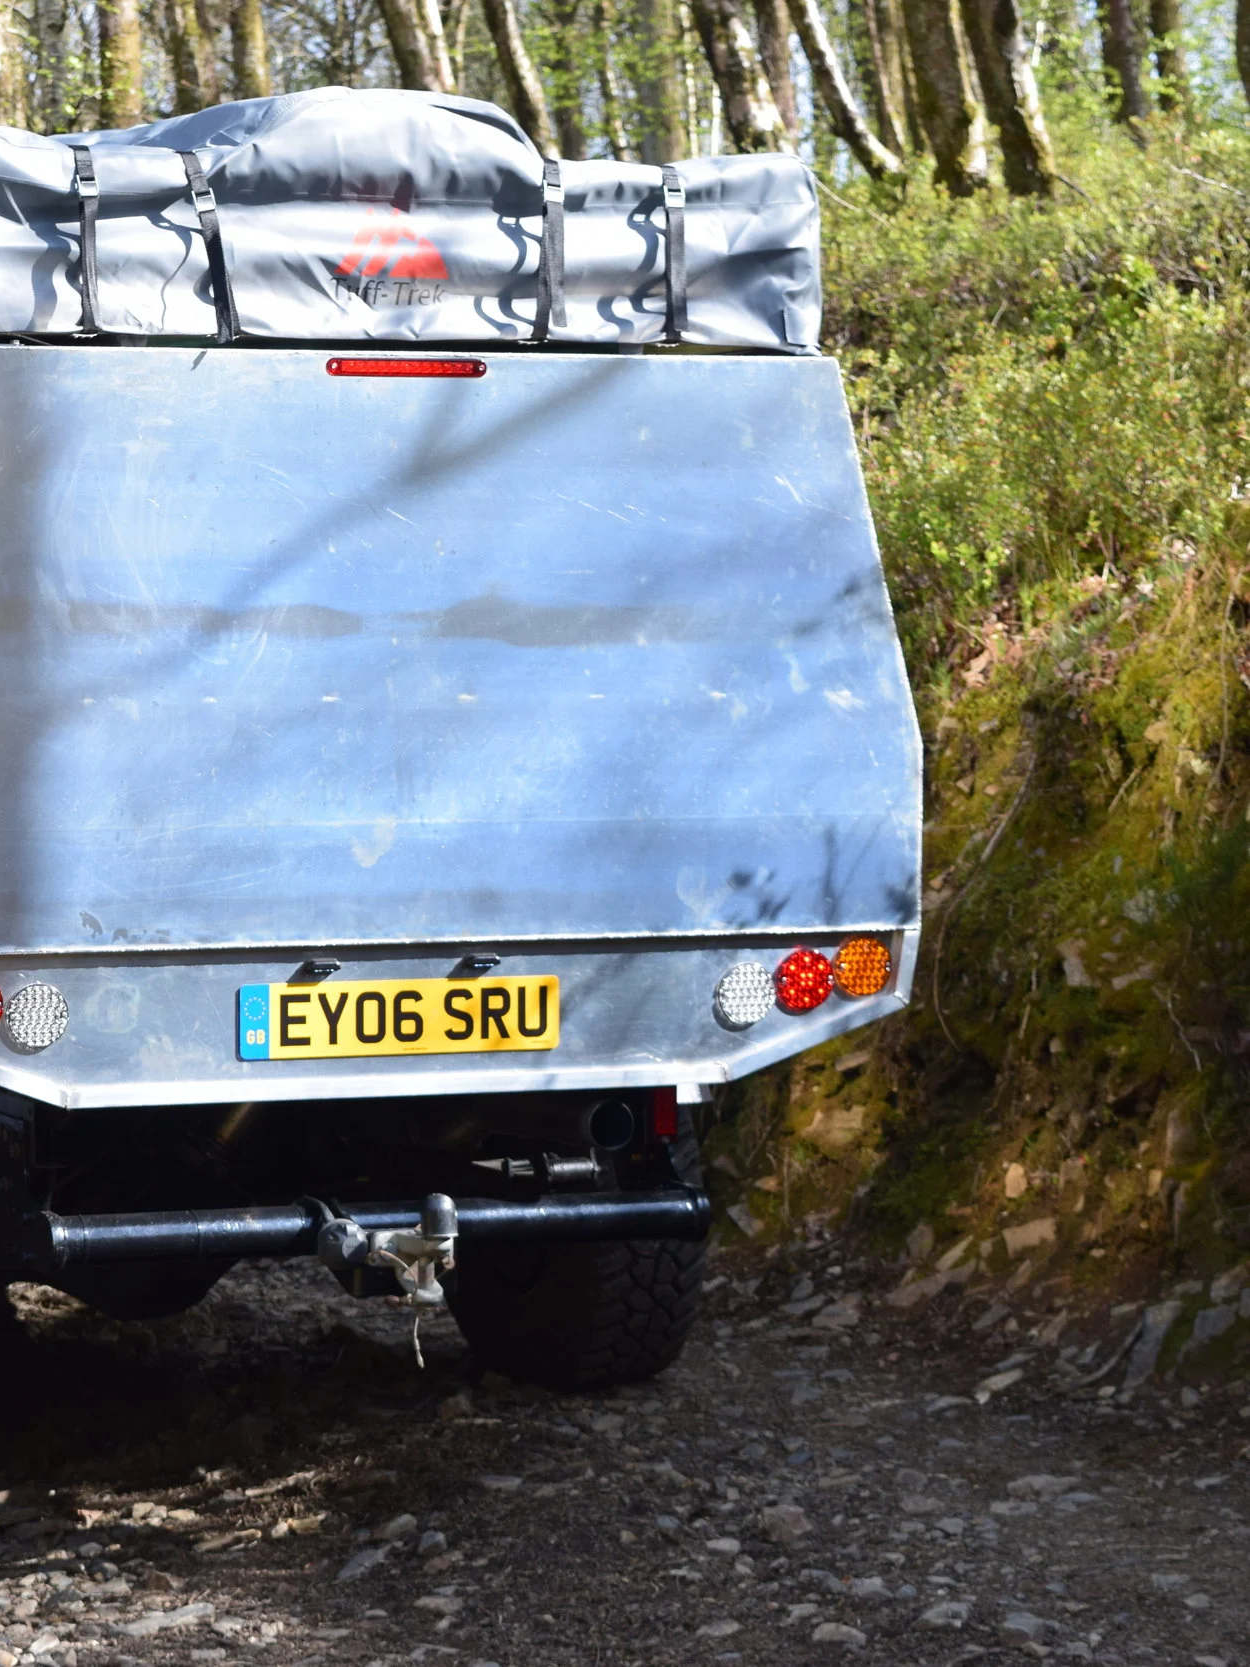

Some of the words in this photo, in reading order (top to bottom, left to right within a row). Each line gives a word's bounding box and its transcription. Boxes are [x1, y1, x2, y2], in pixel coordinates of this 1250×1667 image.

[280, 990, 424, 1047] EY06
[443, 985, 548, 1041] SRU
[246, 1029, 266, 1045] GB
